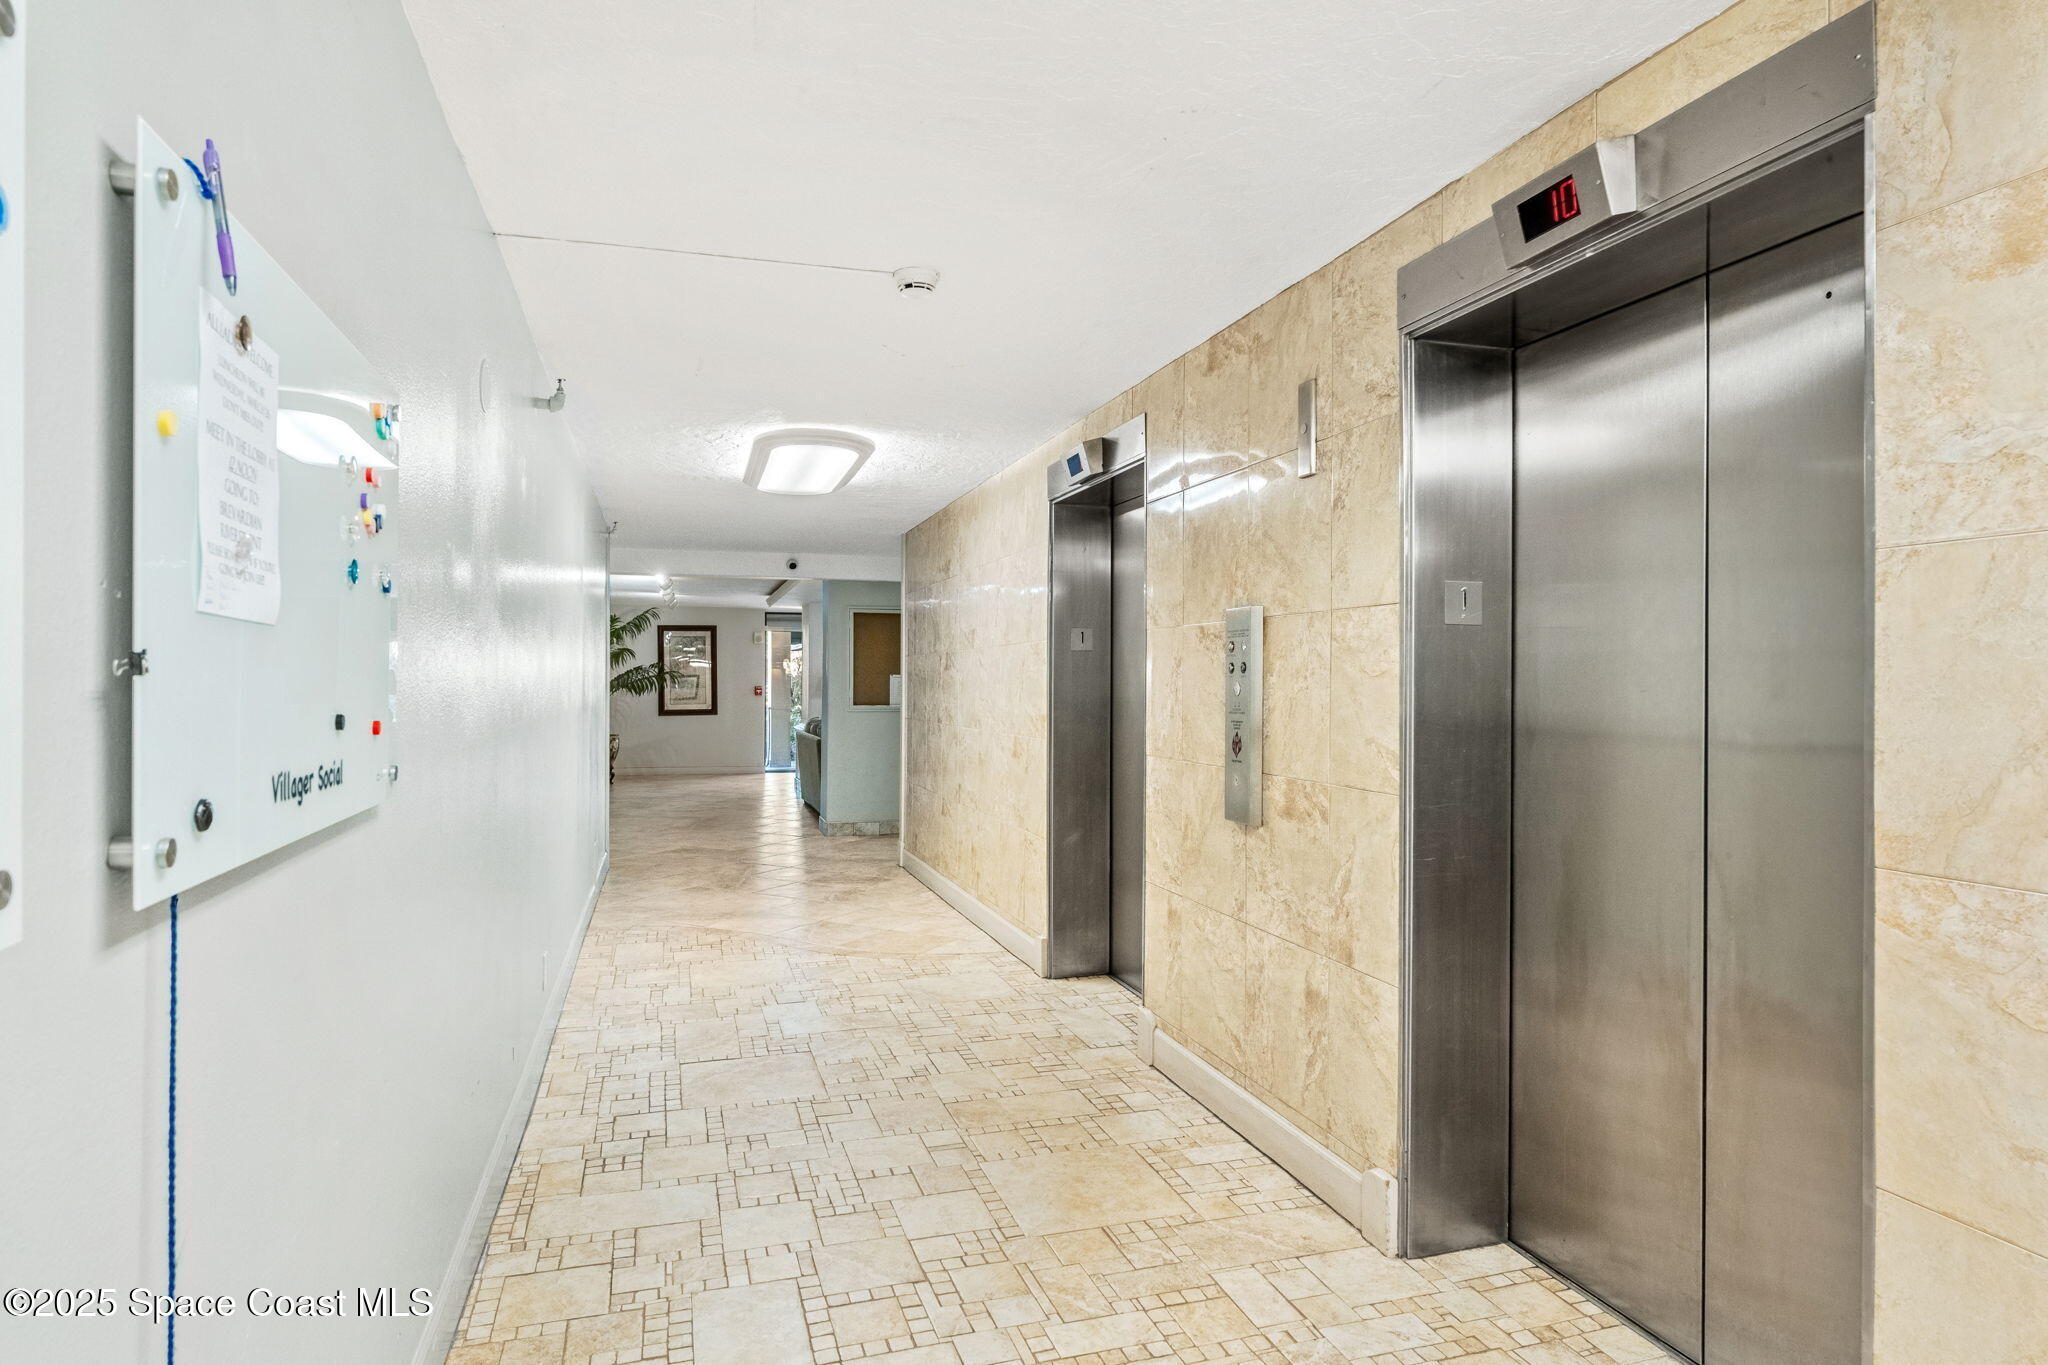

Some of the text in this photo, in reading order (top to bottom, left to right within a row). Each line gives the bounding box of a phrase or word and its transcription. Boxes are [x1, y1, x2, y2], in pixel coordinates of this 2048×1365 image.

[1551, 178, 1578, 223] 10
[272, 757, 344, 807] Villager Social
